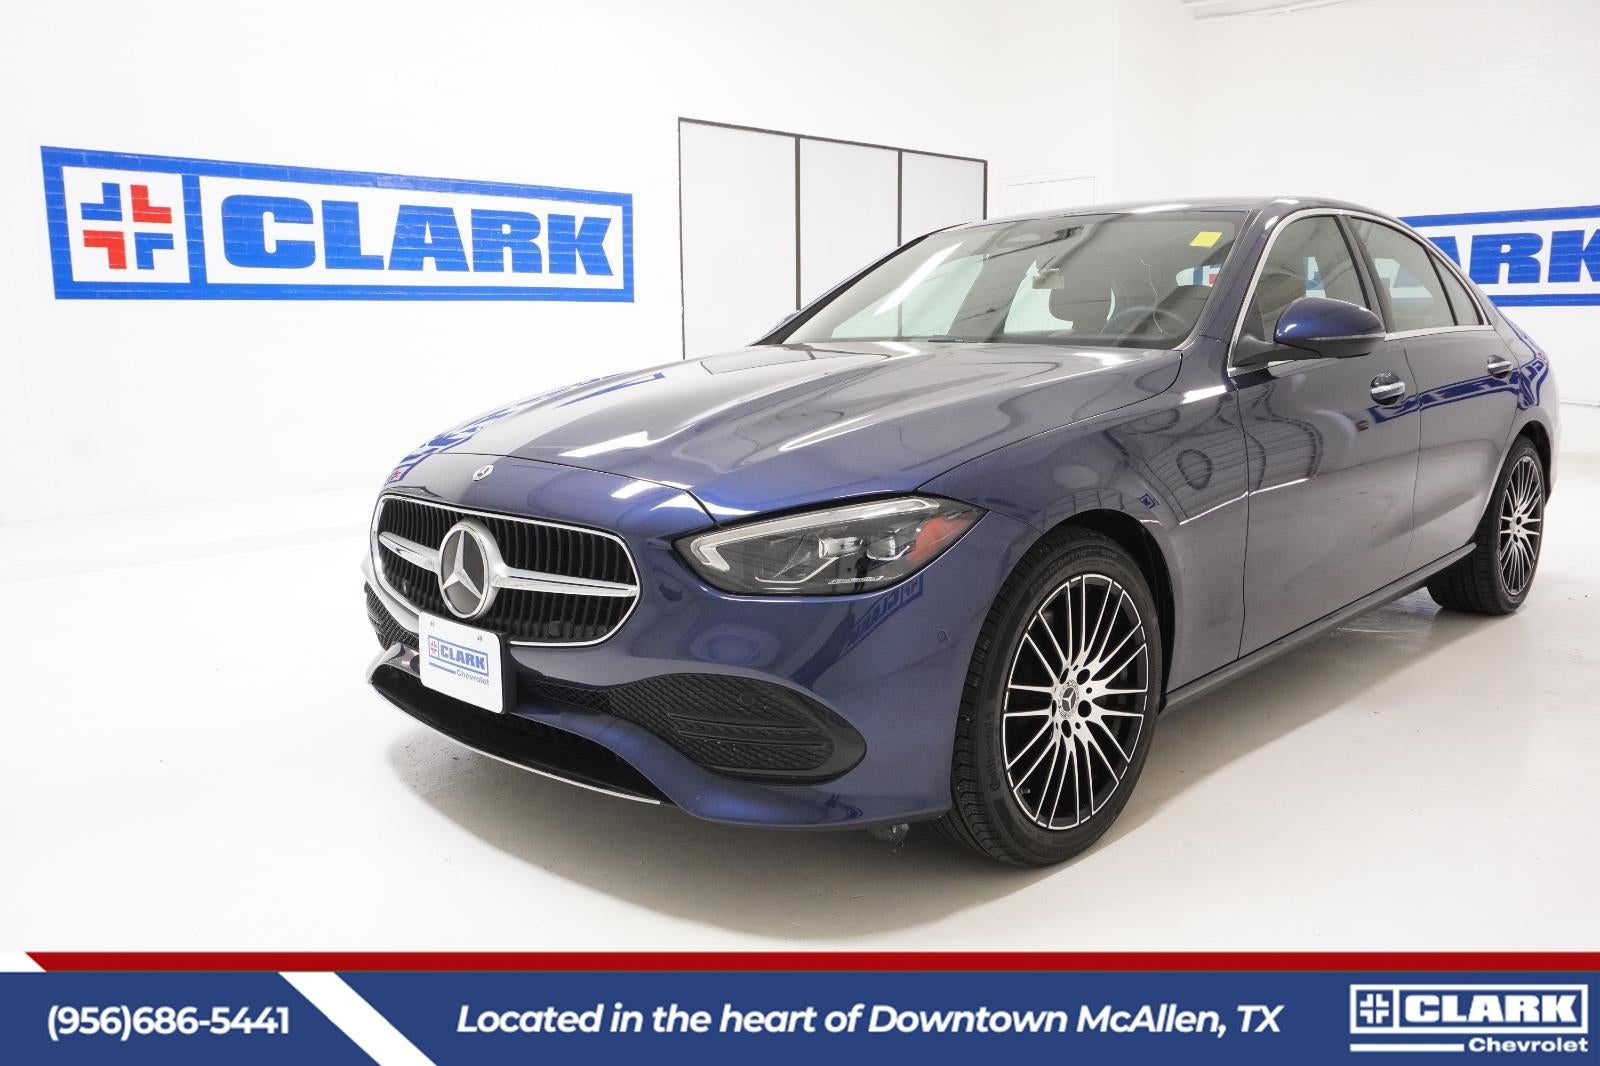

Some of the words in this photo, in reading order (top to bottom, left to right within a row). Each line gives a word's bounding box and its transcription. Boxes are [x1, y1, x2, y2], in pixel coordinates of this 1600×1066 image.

[221, 193, 613, 276] CLARK
[440, 644, 485, 670] CLARK
[456, 669, 490, 685] Chevrolet
